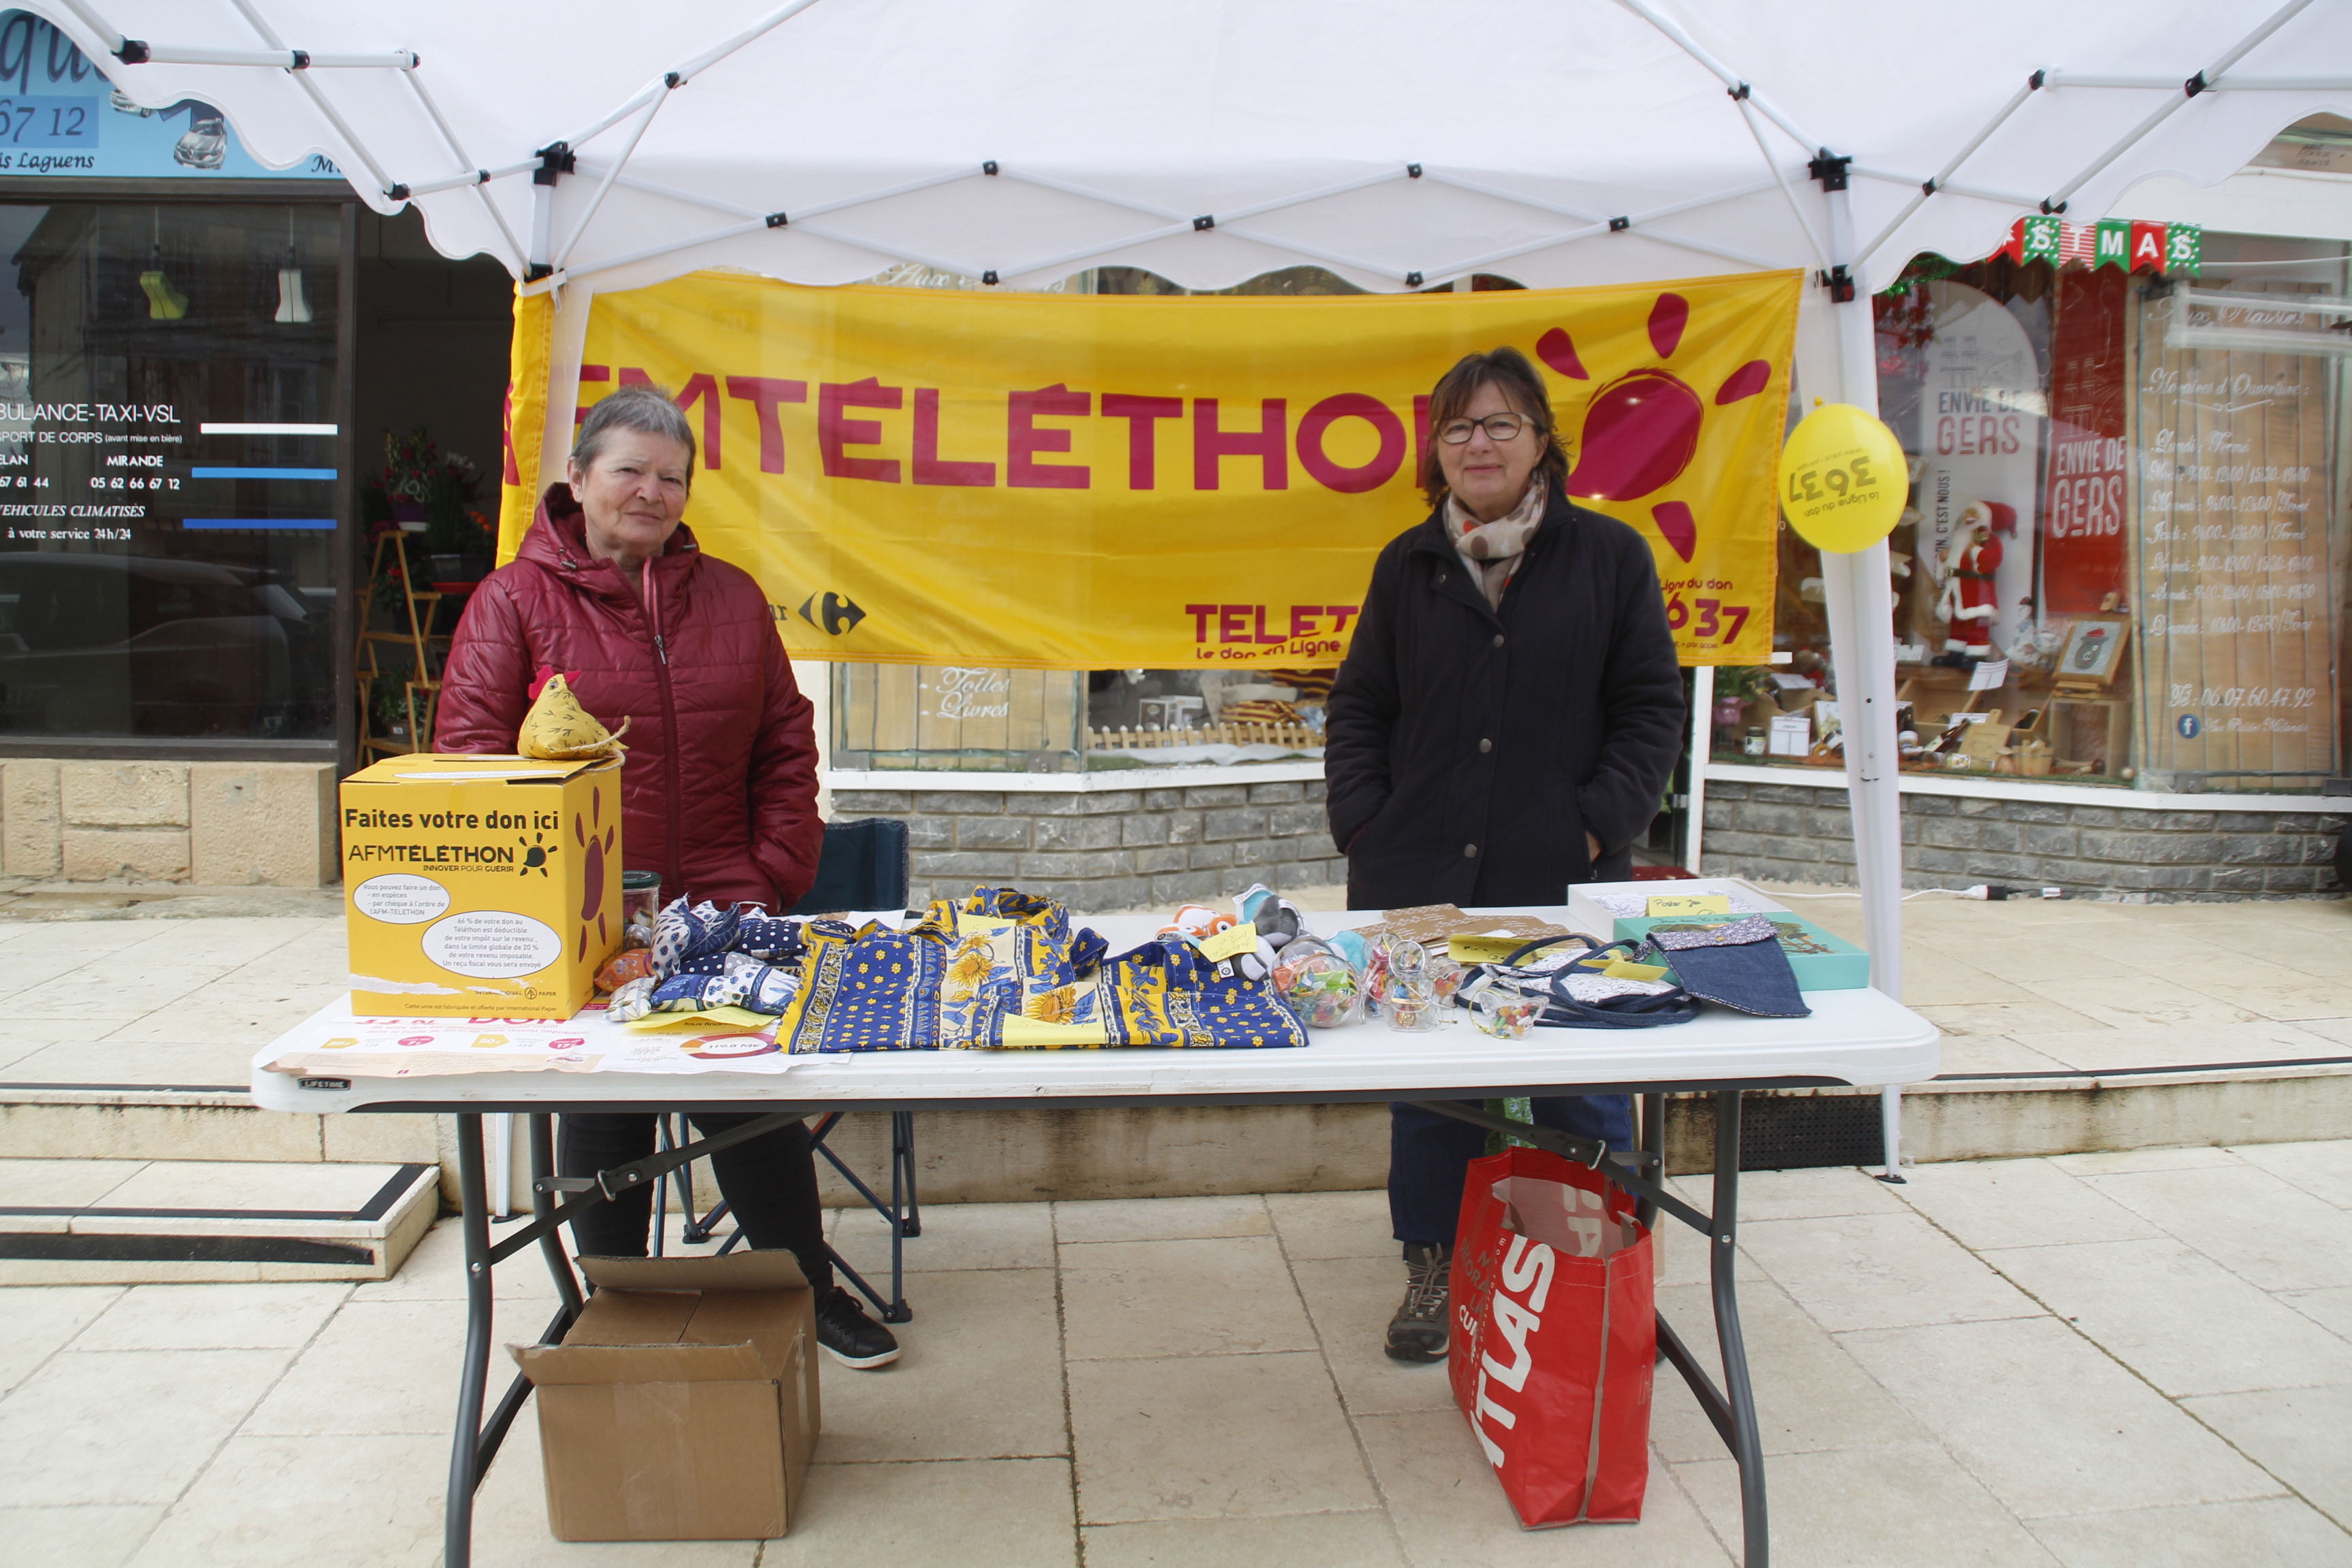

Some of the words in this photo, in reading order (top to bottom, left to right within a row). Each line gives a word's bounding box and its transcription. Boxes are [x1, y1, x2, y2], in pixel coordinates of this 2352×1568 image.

[50, 107, 86, 136] 12
[17, 152, 95, 173] Laguens
[1940, 391, 1991, 413] ENVIE
[0, 431, 35, 442] PORT
[39, 432, 55, 442] DE
[60, 432, 103, 444] CORPS
[1938, 415, 2021, 455] GERS
[107, 455, 163, 467] MIRANDE
[2057, 438, 2102, 476] ENVIE
[2106, 435, 2126, 472] DE
[16, 476, 27, 487] 61
[33, 477, 49, 487] 44
[91, 477, 105, 489] 05
[110, 478, 124, 489] 62
[129, 478, 144, 489] 66
[149, 478, 163, 489] 67
[168, 478, 180, 489] 12
[1938, 476, 1950, 508] NOUS
[1822, 501, 1835, 511] du
[1839, 493, 1867, 506] Ligne
[2053, 475, 2122, 538] GERS
[1804, 507, 1820, 517] don
[7, 527, 15, 538] à
[18, 529, 46, 539] votre
[50, 527, 90, 539] service
[94, 528, 131, 540] 24h/24
[1687, 577, 1703, 589] du
[1707, 578, 1733, 590] don
[1290, 640, 1341, 657] Ligne
[936, 667, 1011, 693] Toiles
[936, 691, 1009, 719] Livres
[345, 808, 413, 828] Faites
[419, 811, 479, 829] votre
[485, 810, 527, 830] don
[534, 811, 559, 830] ici
[348, 845, 514, 863] AFMTÉLÉTHON
